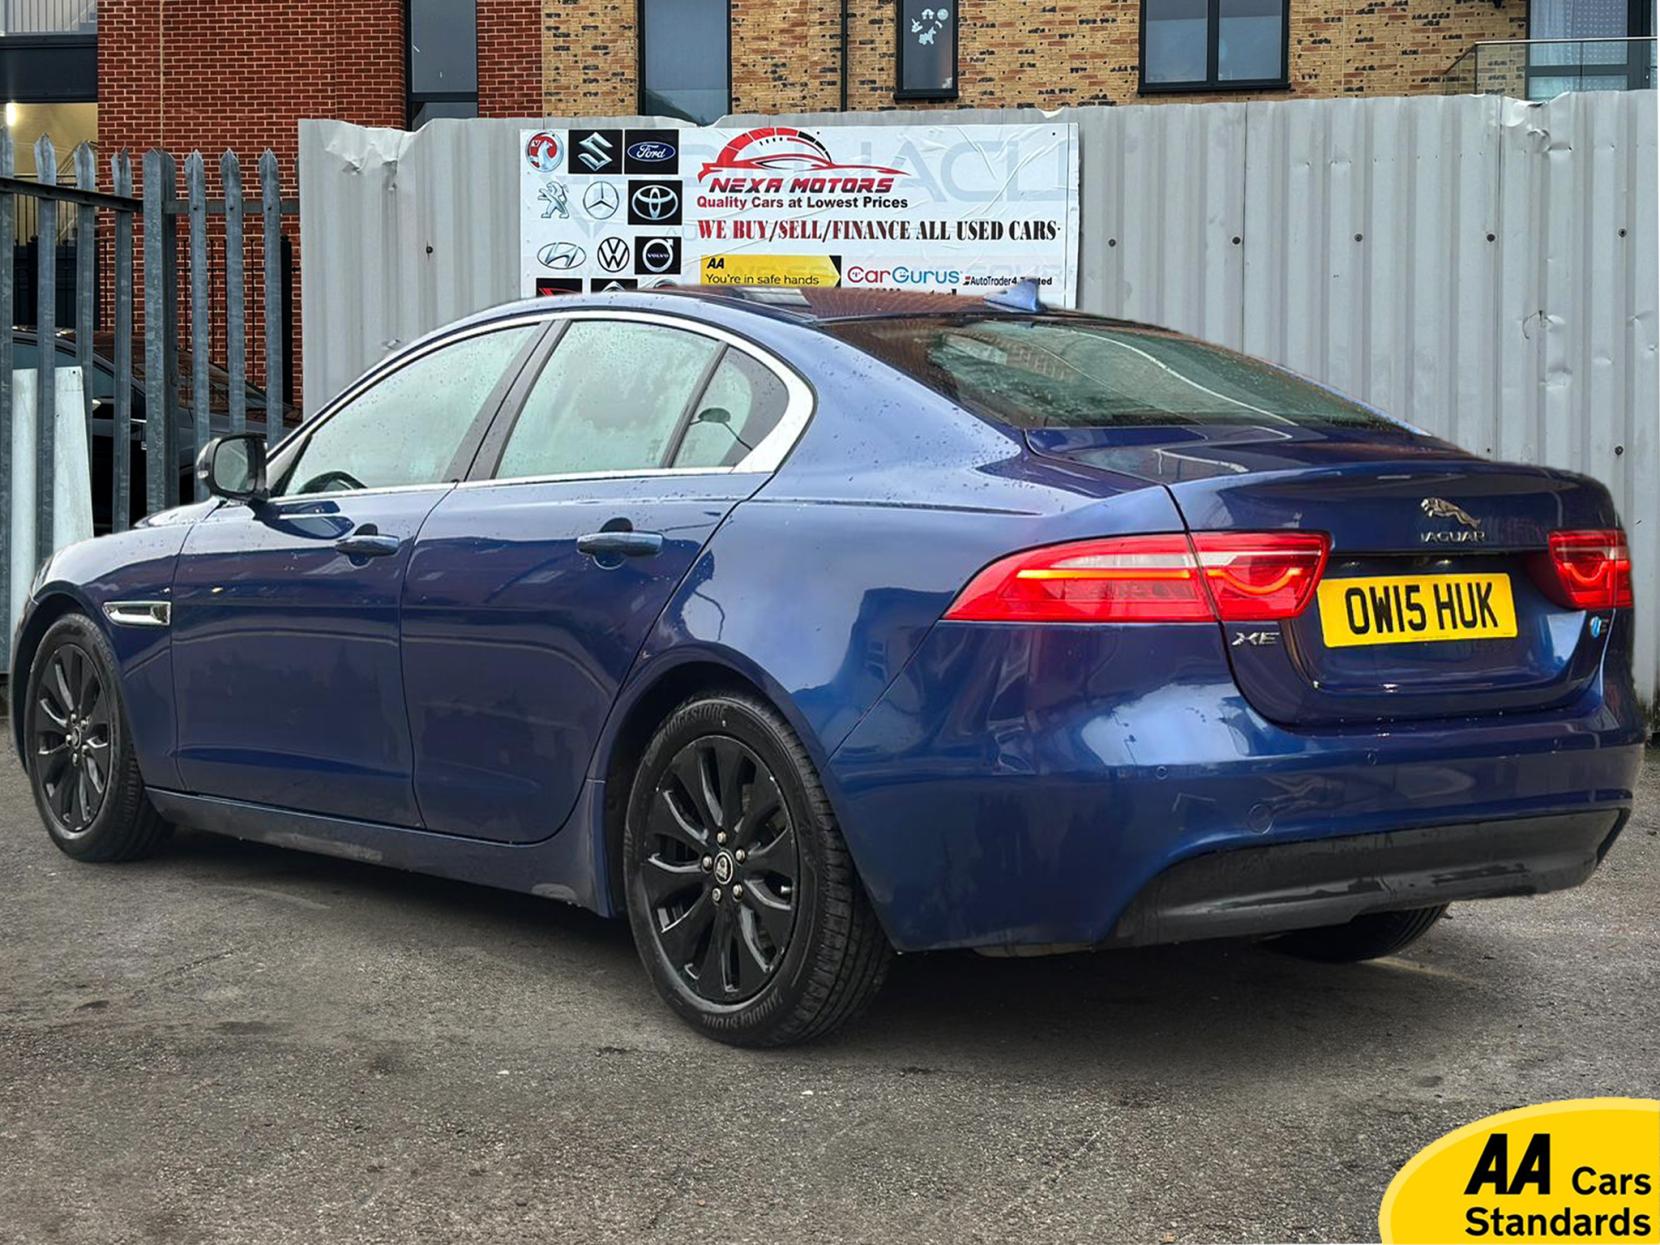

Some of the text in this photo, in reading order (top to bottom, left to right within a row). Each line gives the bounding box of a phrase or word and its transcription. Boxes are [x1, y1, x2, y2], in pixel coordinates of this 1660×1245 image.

[636, 144, 667, 159] Ford
[709, 178, 895, 193] NEXA MOTORS
[697, 196, 909, 210] Quality Cars at Lowest Prices
[697, 220, 726, 239] WE
[916, 220, 950, 240] ALL
[957, 220, 1002, 240] USED
[1009, 220, 1057, 240] CARS
[706, 258, 724, 269] AA
[706, 274, 819, 285] You're in safe hands
[847, 266, 960, 285] CarGurus
[1421, 531, 1485, 542] JAGUAR
[1345, 582, 1498, 635] OW15 HUK
[1232, 632, 1280, 645] XE
